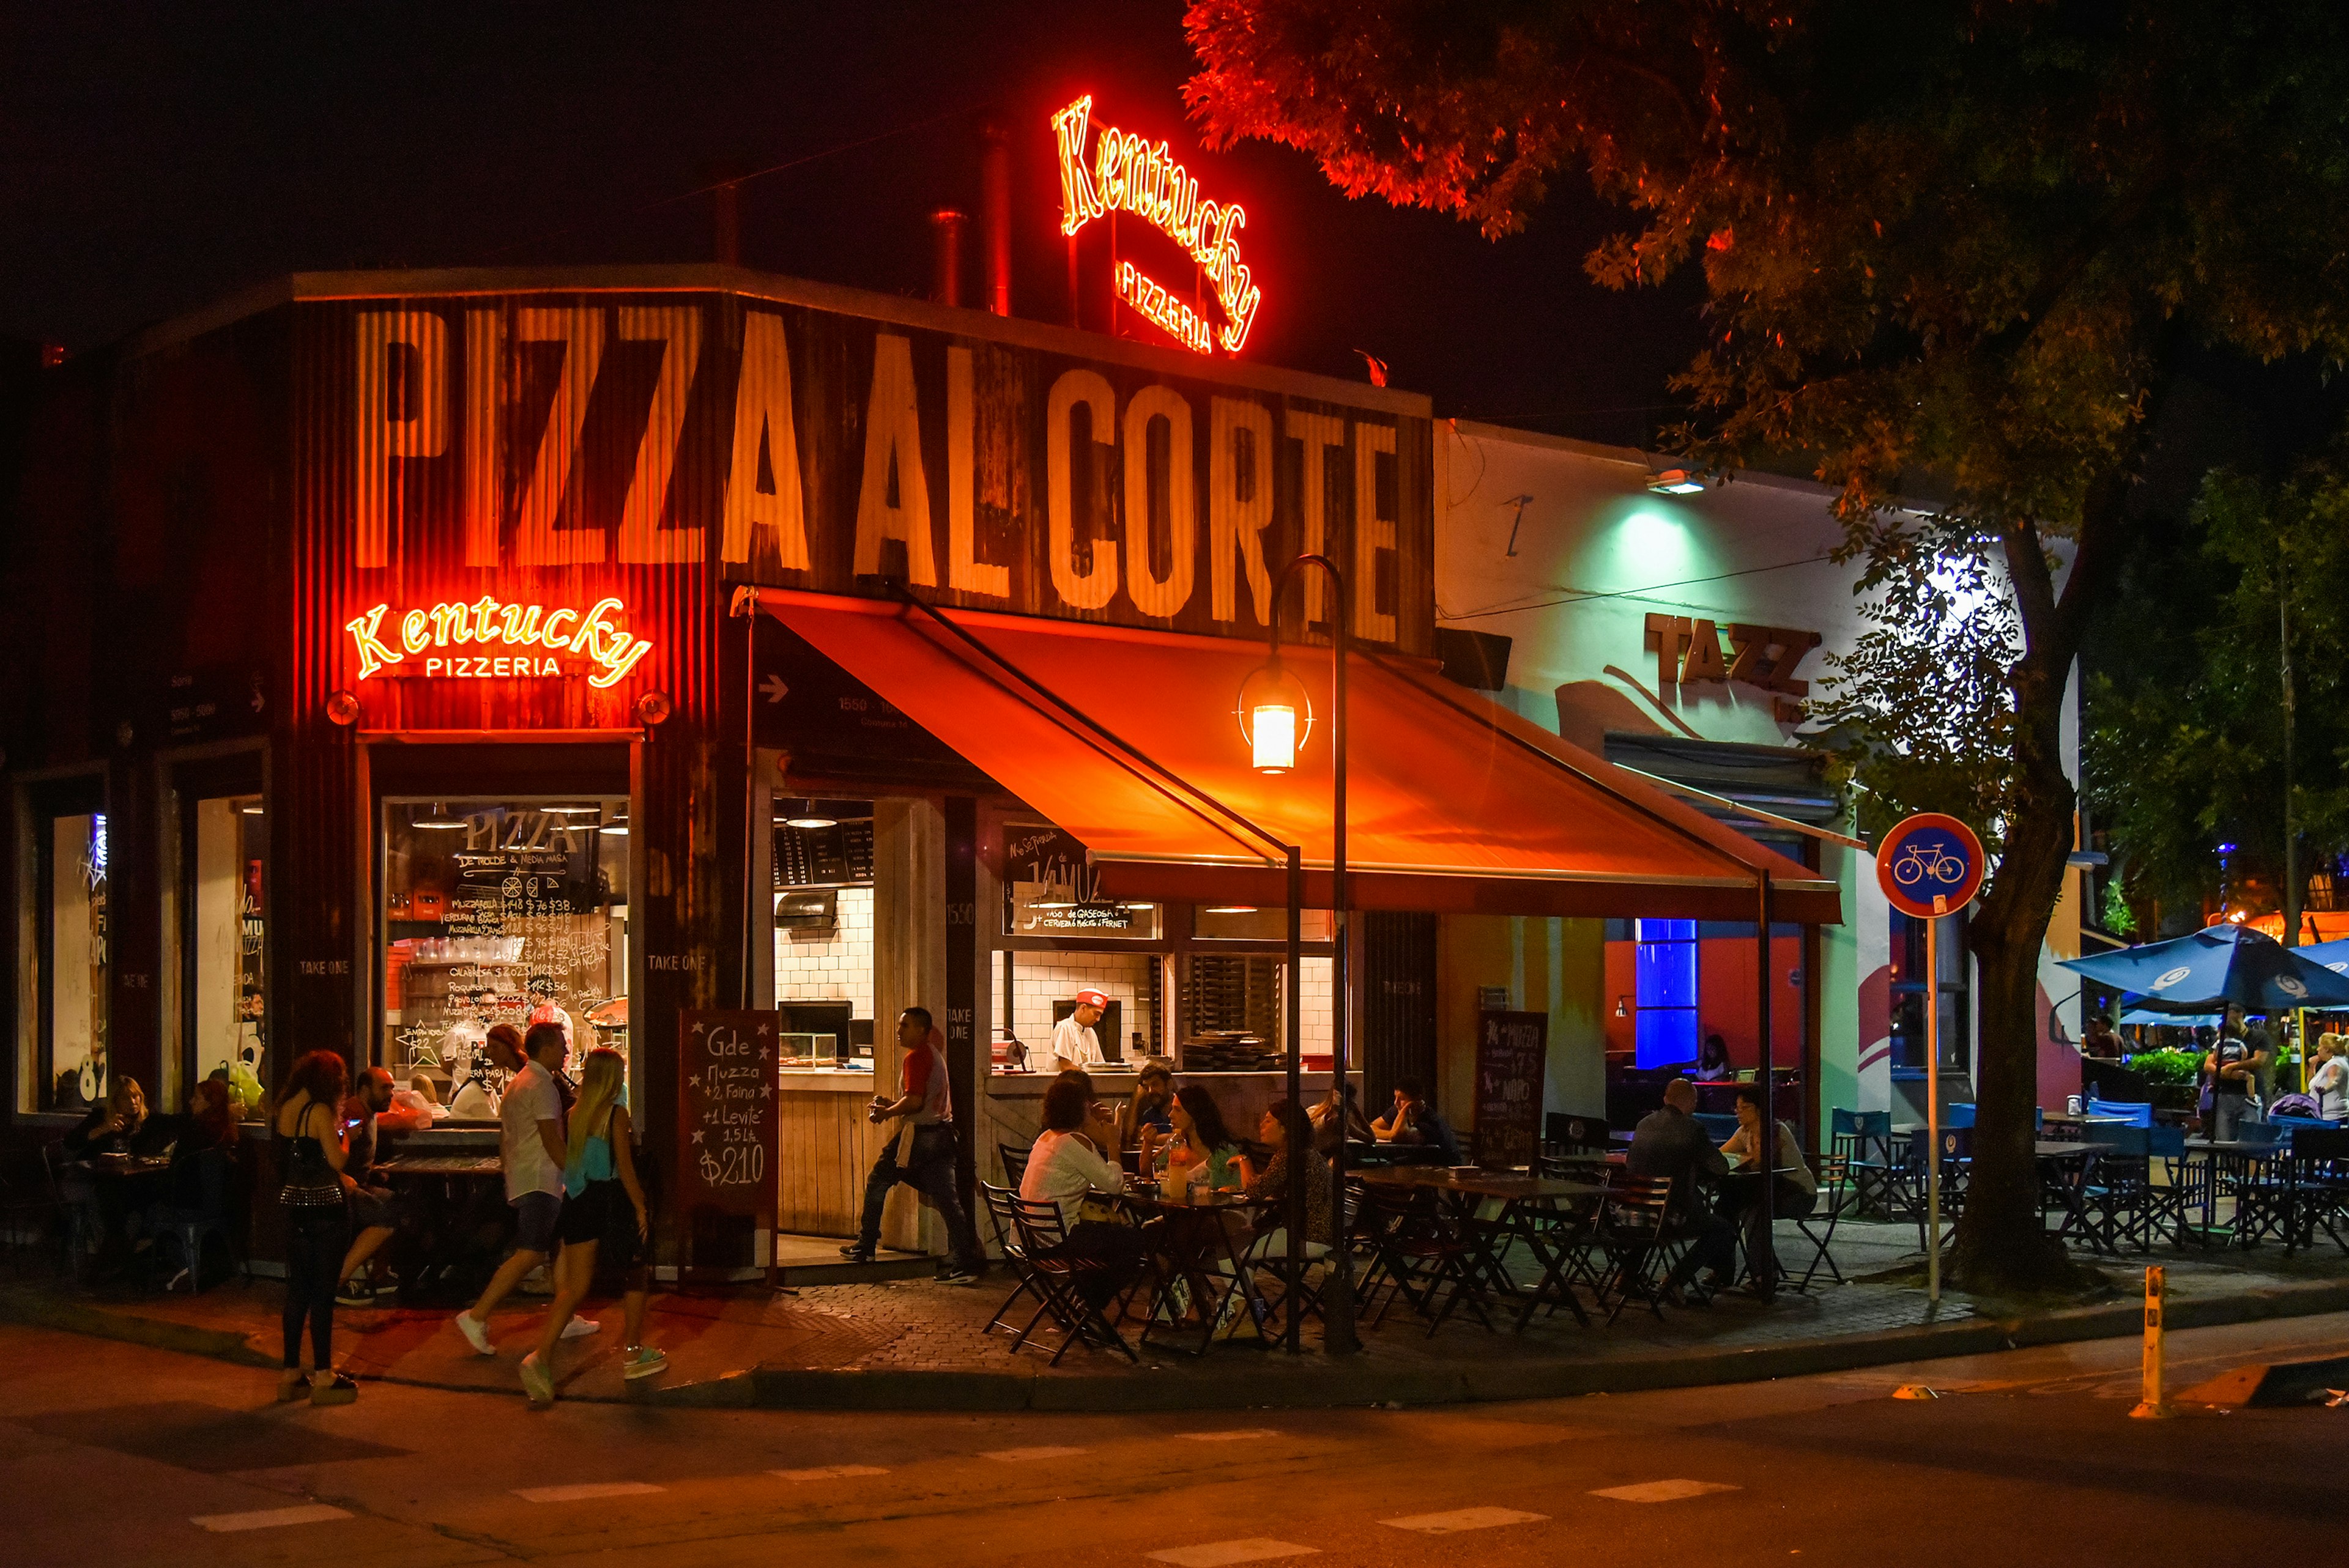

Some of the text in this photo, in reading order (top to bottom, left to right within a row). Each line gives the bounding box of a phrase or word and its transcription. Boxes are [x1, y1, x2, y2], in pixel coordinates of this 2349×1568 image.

[1052, 94, 1261, 352] Kentucky
[1117, 261, 1212, 355] PIZZERIA
[356, 306, 1397, 645] PIZZA AL CORTE
[346, 596, 654, 689] Kentucky
[426, 657, 560, 678] PIZZERIA
[461, 811, 577, 854] PIZZA
[459, 856, 475, 868] DE
[546, 854, 568, 863] MASA
[947, 903, 974, 925] 1550
[1077, 909, 1113, 918] GASEOSA
[300, 960, 349, 975] TAKE ONE
[648, 955, 706, 971] TAKE ONE
[947, 1008, 972, 1023] TAKE
[707, 1026, 751, 1061] Gde
[950, 1026, 968, 1040] ONE
[699, 1144, 763, 1188] $210
